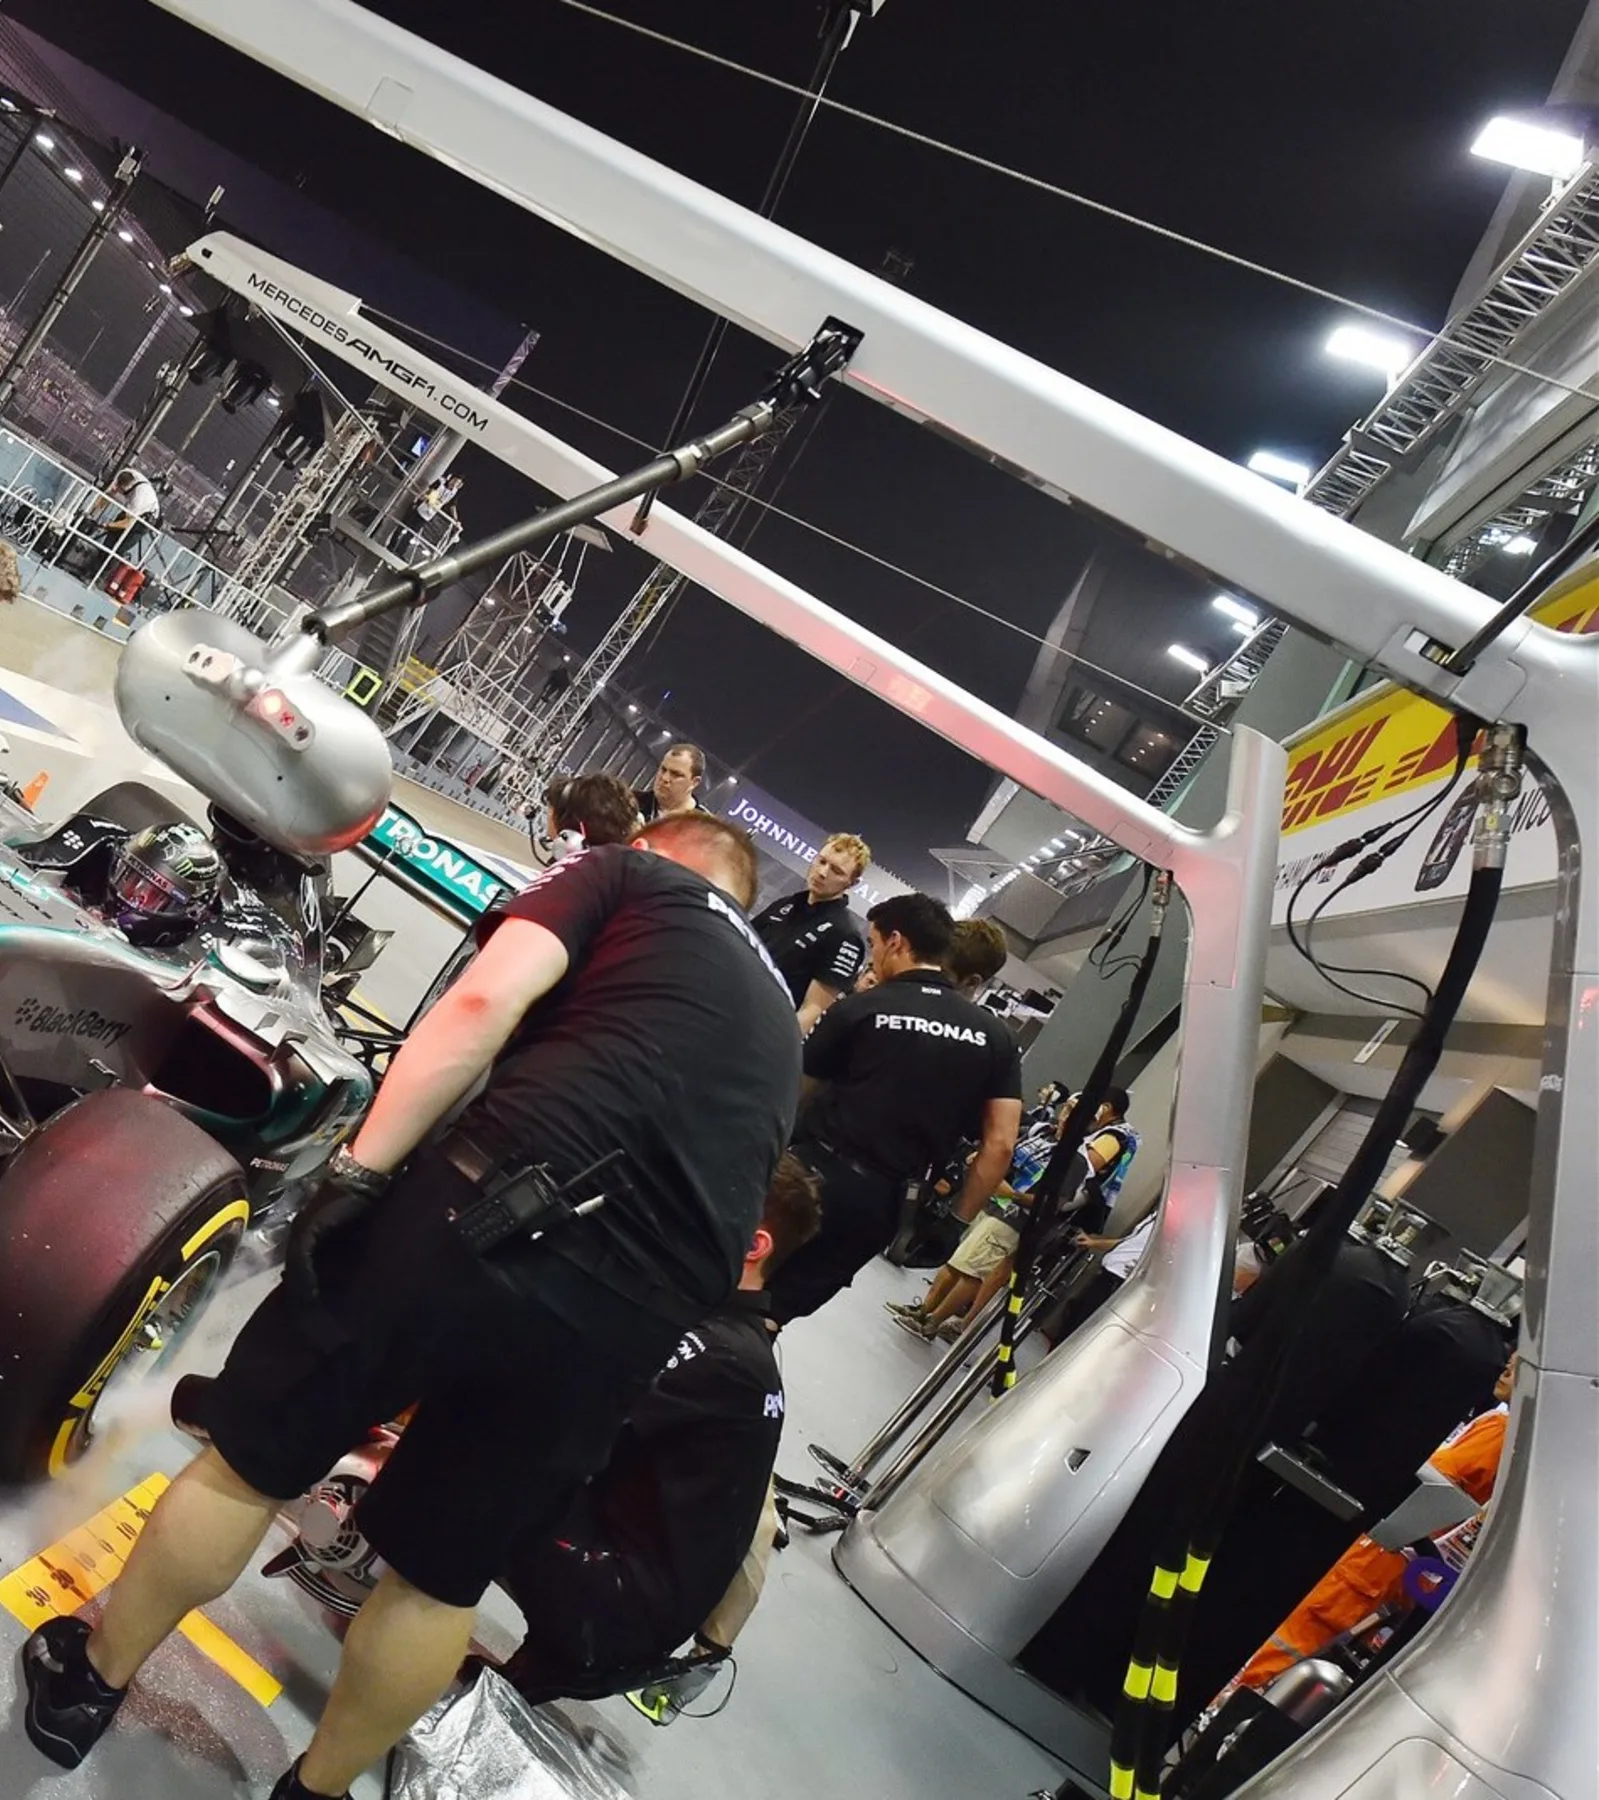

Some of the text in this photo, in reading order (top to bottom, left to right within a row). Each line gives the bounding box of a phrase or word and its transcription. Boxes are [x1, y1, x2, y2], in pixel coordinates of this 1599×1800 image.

[376, 805, 503, 905] TRONAS
[729, 798, 818, 864] JOHNNIE
[874, 1013, 987, 1047] PETRONAS
[25, 1585, 50, 1608] 30
[51, 1568, 75, 1590] 20
[116, 1521, 137, 1541] 10
